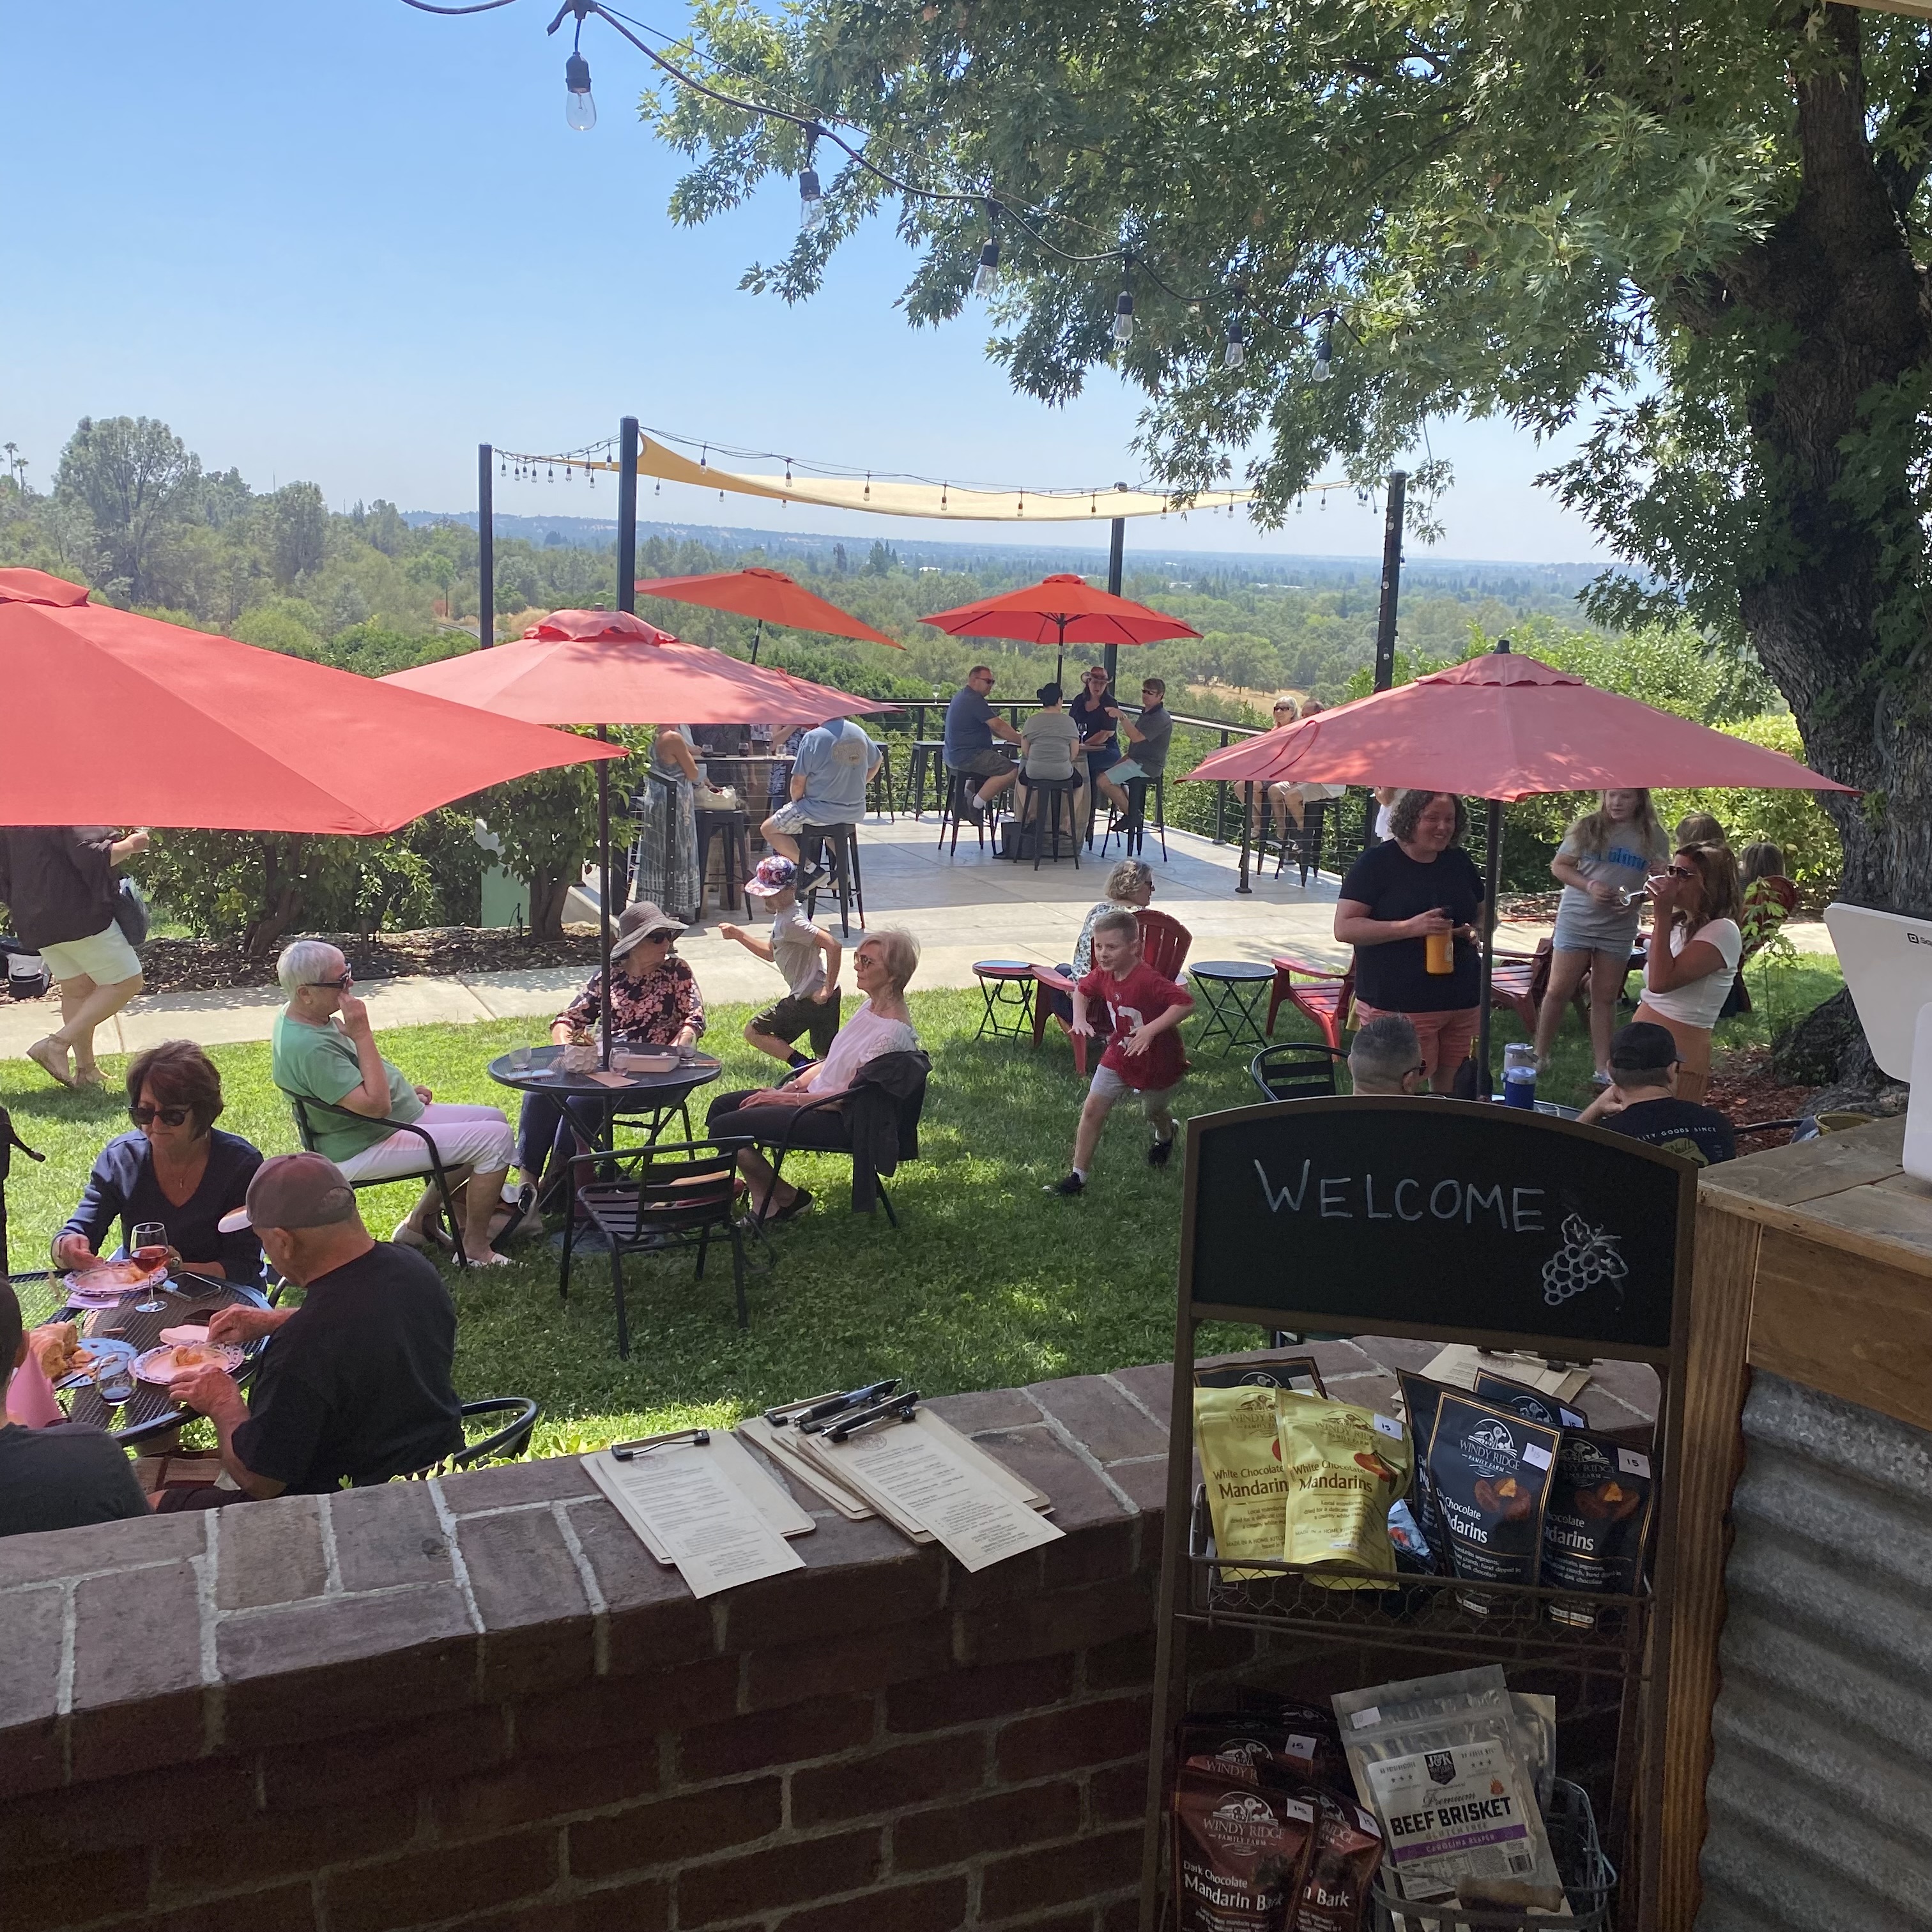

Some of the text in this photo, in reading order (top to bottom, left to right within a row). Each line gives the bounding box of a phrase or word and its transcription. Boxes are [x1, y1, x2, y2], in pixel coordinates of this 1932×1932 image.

[1661, 1127, 1690, 1137] GOODS
[1254, 1158, 1545, 1232] WELCOME
[1229, 1414, 1265, 1423] WINDY
[1315, 1421, 1350, 1436] WINDY
[1460, 1439, 1521, 1471] WINDY RIDGE
[1468, 1455, 1505, 1473] FAMILY FARM
[1627, 1459, 1640, 1468] 15
[1213, 1465, 1285, 1481] White Chocolate
[1291, 1459, 1366, 1475] White Chocolate
[1218, 1478, 1288, 1499] Mandarin
[1299, 1473, 1373, 1493] Mandarins
[1445, 1496, 1482, 1521] Chocolate
[1472, 1567, 1497, 1578] chocolate
[1206, 1759, 1250, 1779] WINDY
[1390, 1797, 1511, 1837] BEEF BRISKET
[1203, 1818, 1284, 1840] WINDY RIDGE
[1322, 1820, 1356, 1844] RIDGE
[1217, 1834, 1267, 1846] FAMILY FARM
[1425, 1839, 1466, 1853] CAROLINA
[1183, 1860, 1248, 1889] Dark Chocolate
[1184, 1873, 1250, 1910] Mandarin
[1316, 1887, 1349, 1908] Bark
